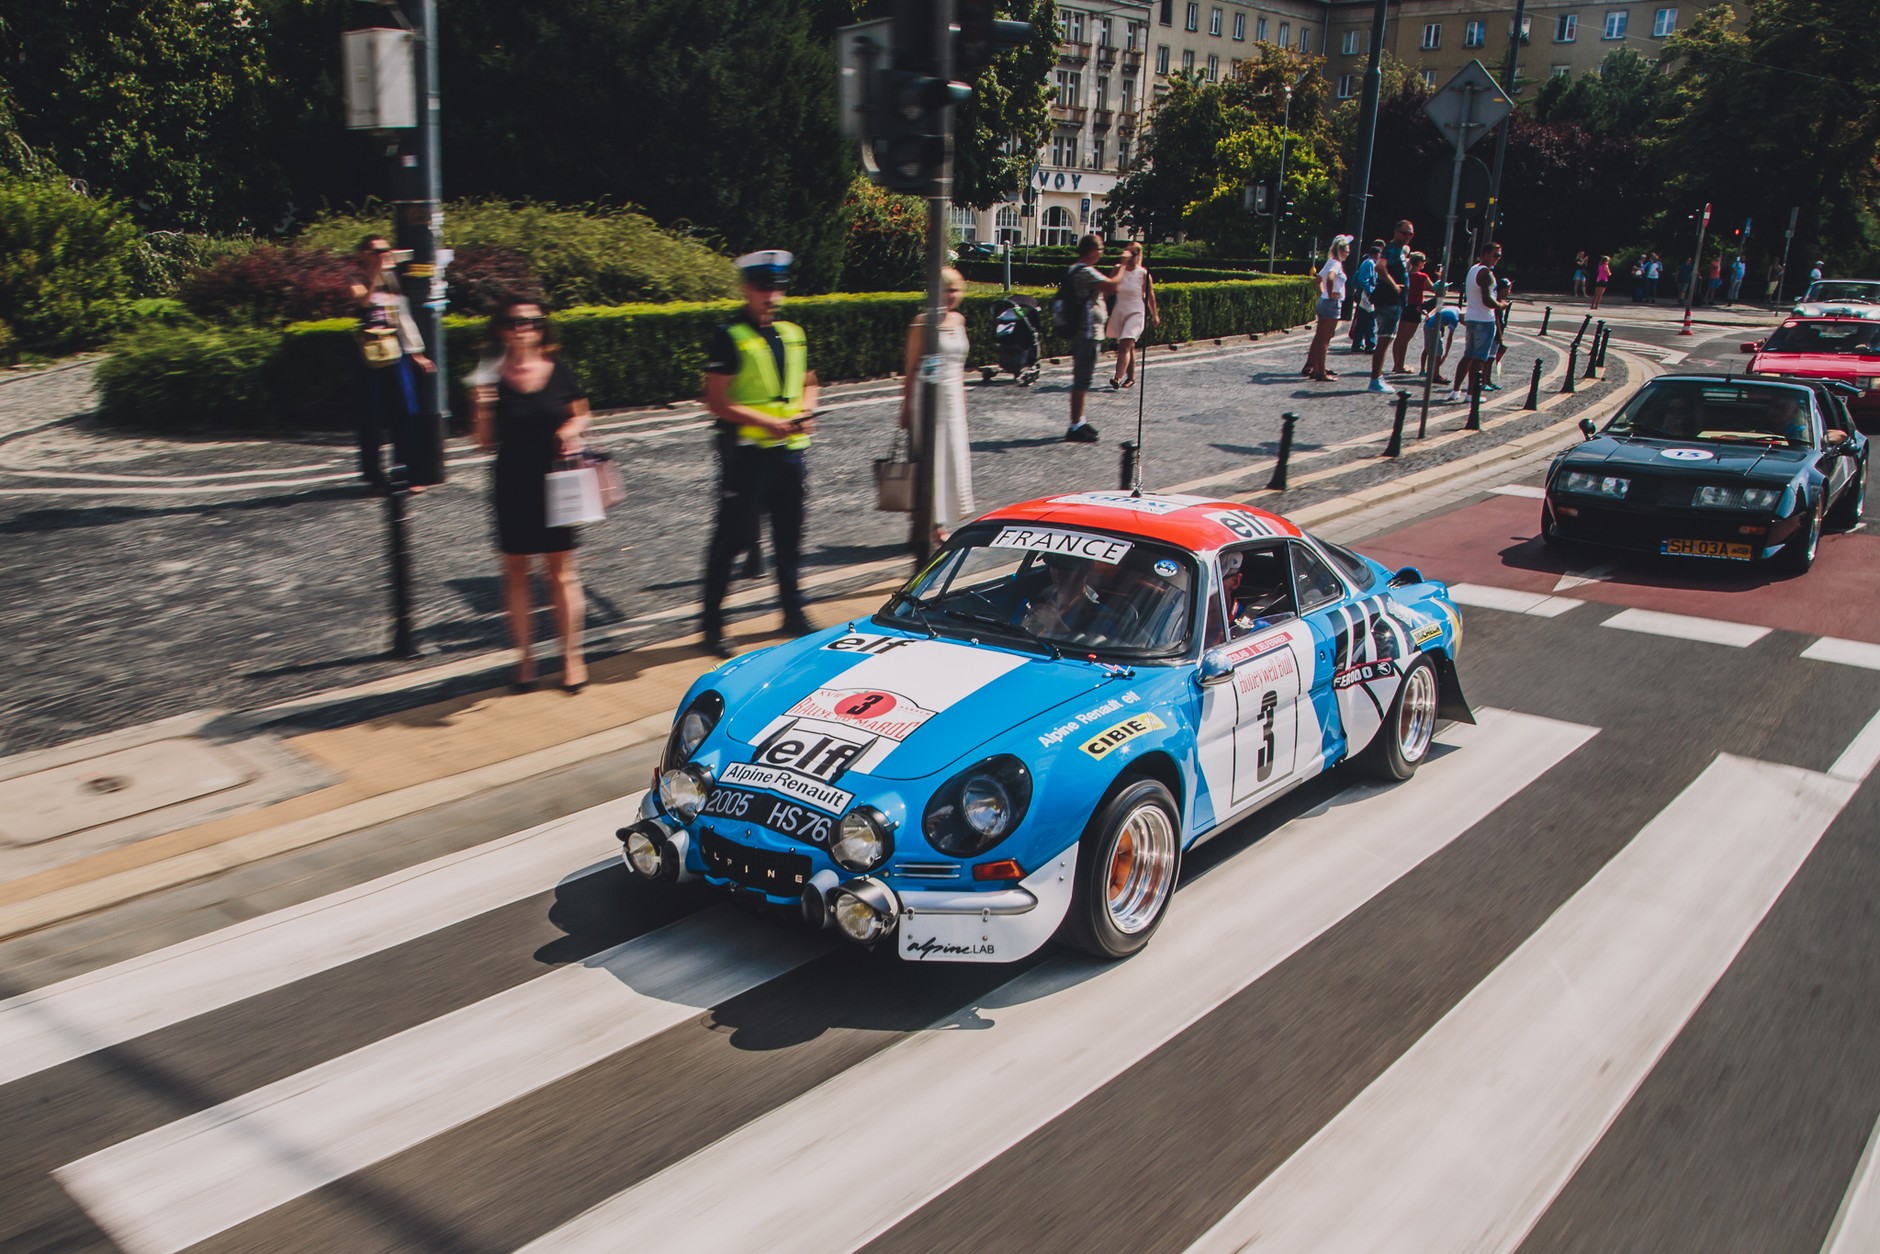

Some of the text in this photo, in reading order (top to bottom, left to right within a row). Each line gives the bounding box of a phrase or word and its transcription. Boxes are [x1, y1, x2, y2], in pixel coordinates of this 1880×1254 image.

[1219, 510, 1273, 538] elf
[996, 529, 1125, 560] FRANCE
[1669, 539, 1729, 556] SH 03A
[827, 636, 918, 655] elf
[1333, 665, 1373, 688] FERODO
[790, 696, 834, 718] RALLYE
[854, 716, 921, 740] MAROC
[846, 694, 885, 716] 3
[1038, 690, 1141, 748] Alpine Renault elf
[1087, 720, 1146, 755] CIBIE
[1256, 689, 1278, 783] 3
[765, 736, 860, 777] elf
[726, 765, 845, 808] Alpine Renault
[705, 788, 754, 817] 2005
[973, 944, 995, 955] LAB
